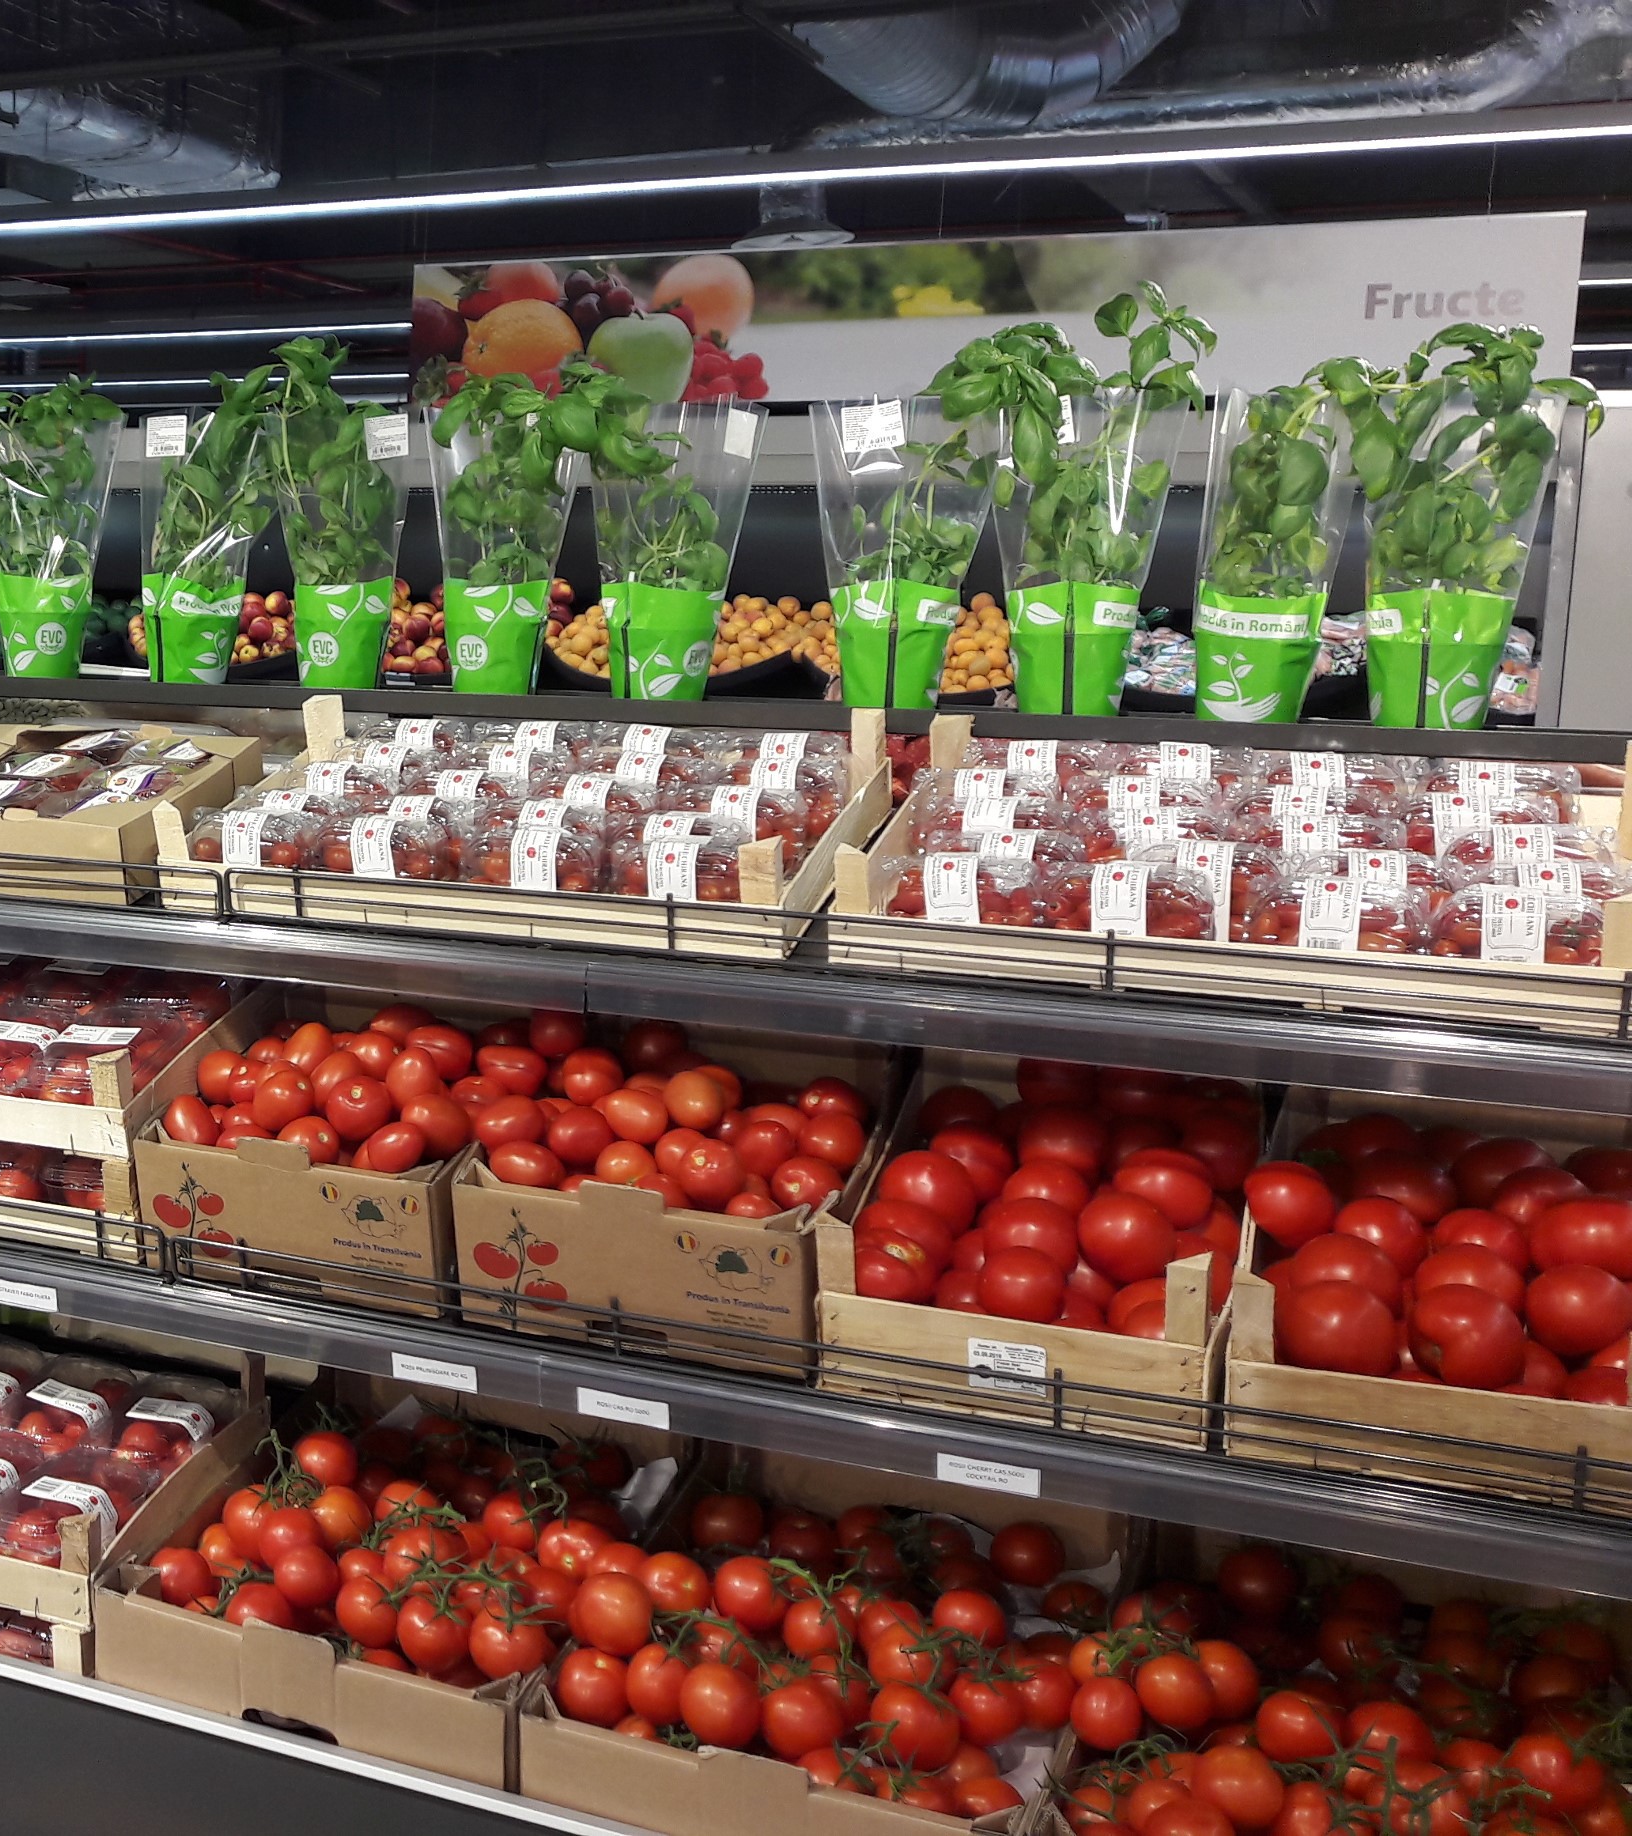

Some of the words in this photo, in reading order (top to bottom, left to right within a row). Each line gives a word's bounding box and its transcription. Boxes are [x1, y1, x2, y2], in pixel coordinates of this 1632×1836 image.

[1364, 281, 1526, 320] Fructe
[41, 630, 63, 644] EVC
[313, 639, 333, 655] EVC
[460, 643, 483, 658] EVC
[333, 1237, 362, 1250] Produs
[686, 1290, 719, 1304] Produs
